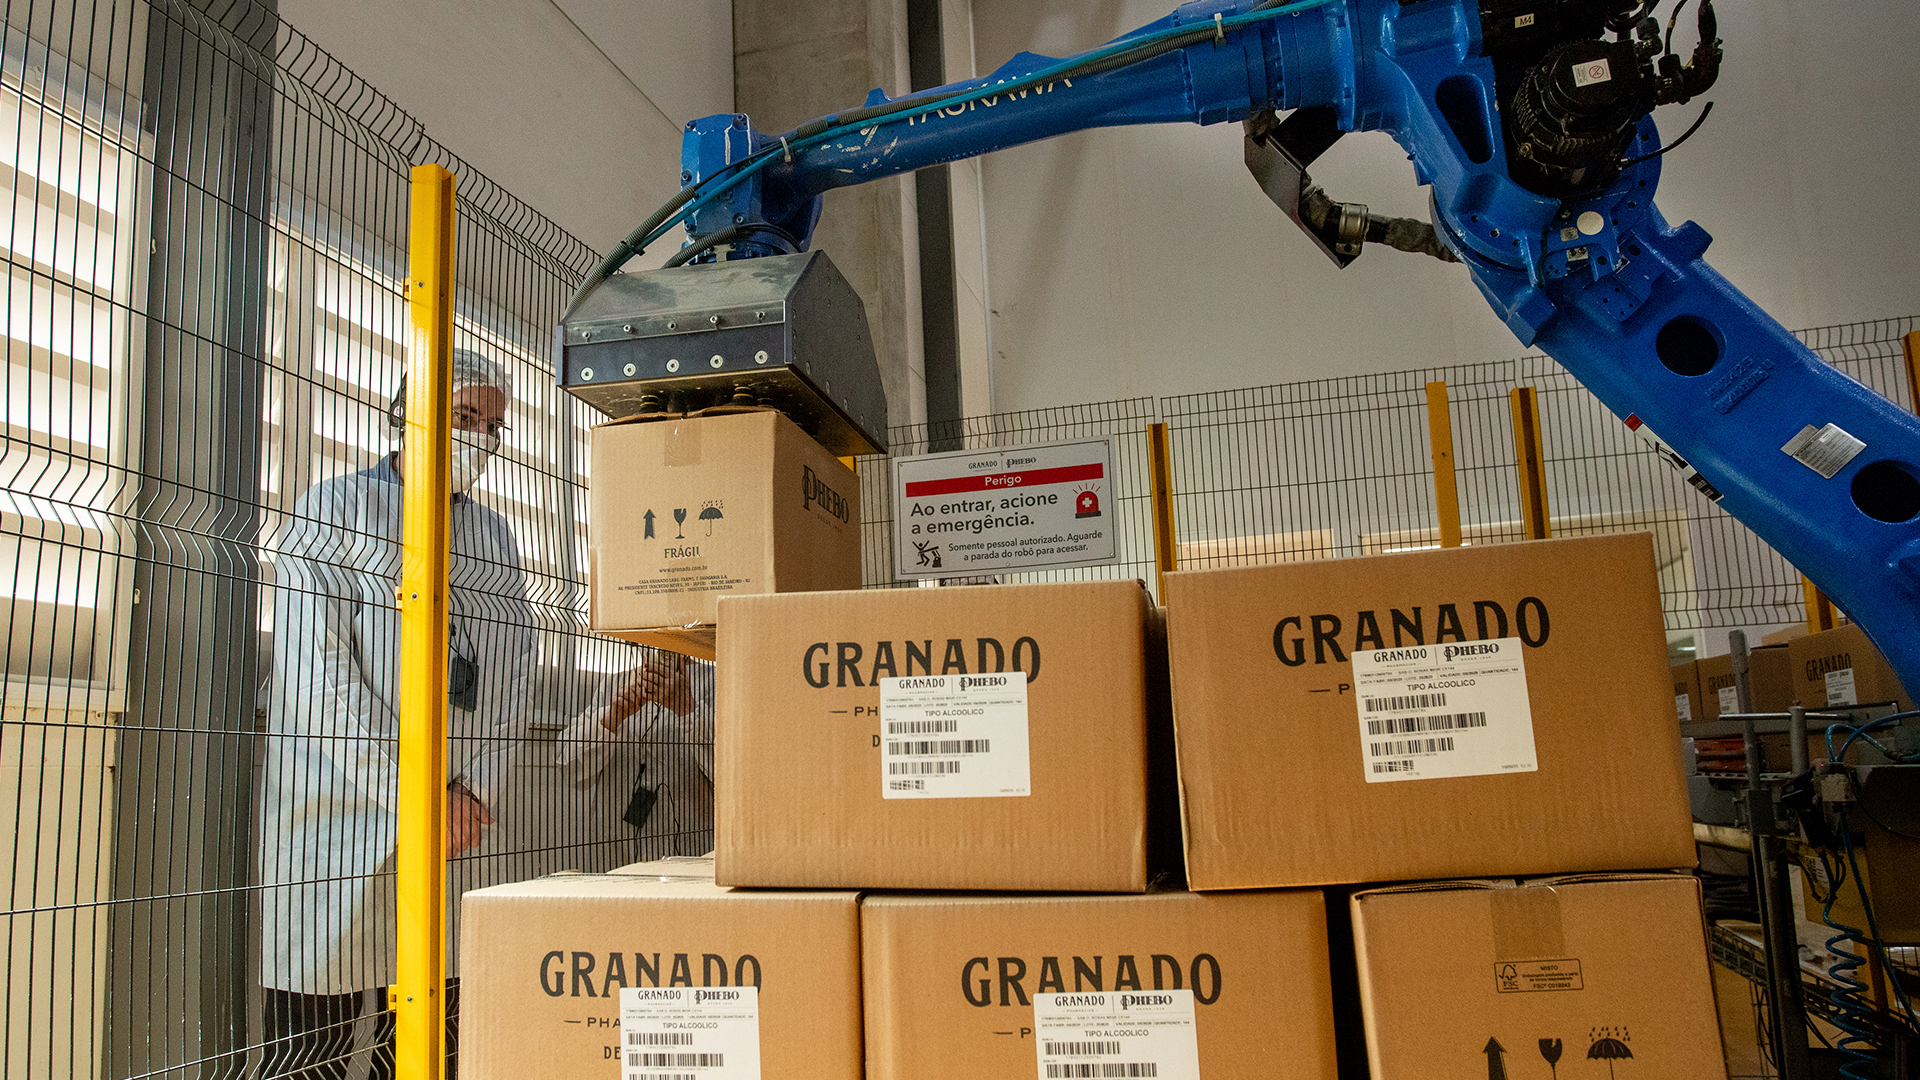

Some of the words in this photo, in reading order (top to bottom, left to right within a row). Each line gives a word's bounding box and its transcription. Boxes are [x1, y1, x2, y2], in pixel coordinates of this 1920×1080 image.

[1520, 16, 1532, 25] M4
[968, 460, 998, 469] GRANADO
[1006, 457, 1037, 468] PHEBO
[985, 475, 1022, 486] Perigo
[802, 464, 849, 524] PHEBO
[910, 502, 935, 517] Ao
[940, 500, 996, 515] entrar,
[1000, 493, 1058, 509] acione
[911, 524, 921, 535] a
[926, 512, 1035, 534] emergência.
[948, 542, 985, 552] Somente
[986, 538, 1018, 551] pessoal
[1019, 534, 1066, 546] autorizado.
[1066, 530, 1103, 543] Aguarde
[963, 553, 969, 561] a
[970, 550, 1000, 562] parada
[1001, 549, 1013, 558] do
[1014, 546, 1034, 558] robô
[1036, 547, 1055, 558] para
[1056, 543, 1089, 554] acessar.
[1273, 597, 1550, 667] GRANADO
[803, 636, 1041, 689] GRANADO
[1374, 648, 1427, 663] GRANADO
[1443, 643, 1500, 662] PHEBO
[1806, 653, 1851, 681] GRANADO
[899, 678, 945, 689] GRANADO
[959, 676, 1007, 691] PHEBO
[1407, 683, 1426, 691] TIPO
[1427, 679, 1476, 690] ALCOOLICO
[942, 708, 984, 716] ALCOOLICO
[540, 951, 762, 998] GRANADO
[961, 953, 1222, 1007] GRANADO
[638, 990, 681, 1000] GRANADO
[694, 990, 740, 1005] PHEBO
[1055, 995, 1105, 1006] GRANADO
[1120, 994, 1173, 1010] PHEBO
[1104, 1029, 1149, 1037] ALCOOLICO
